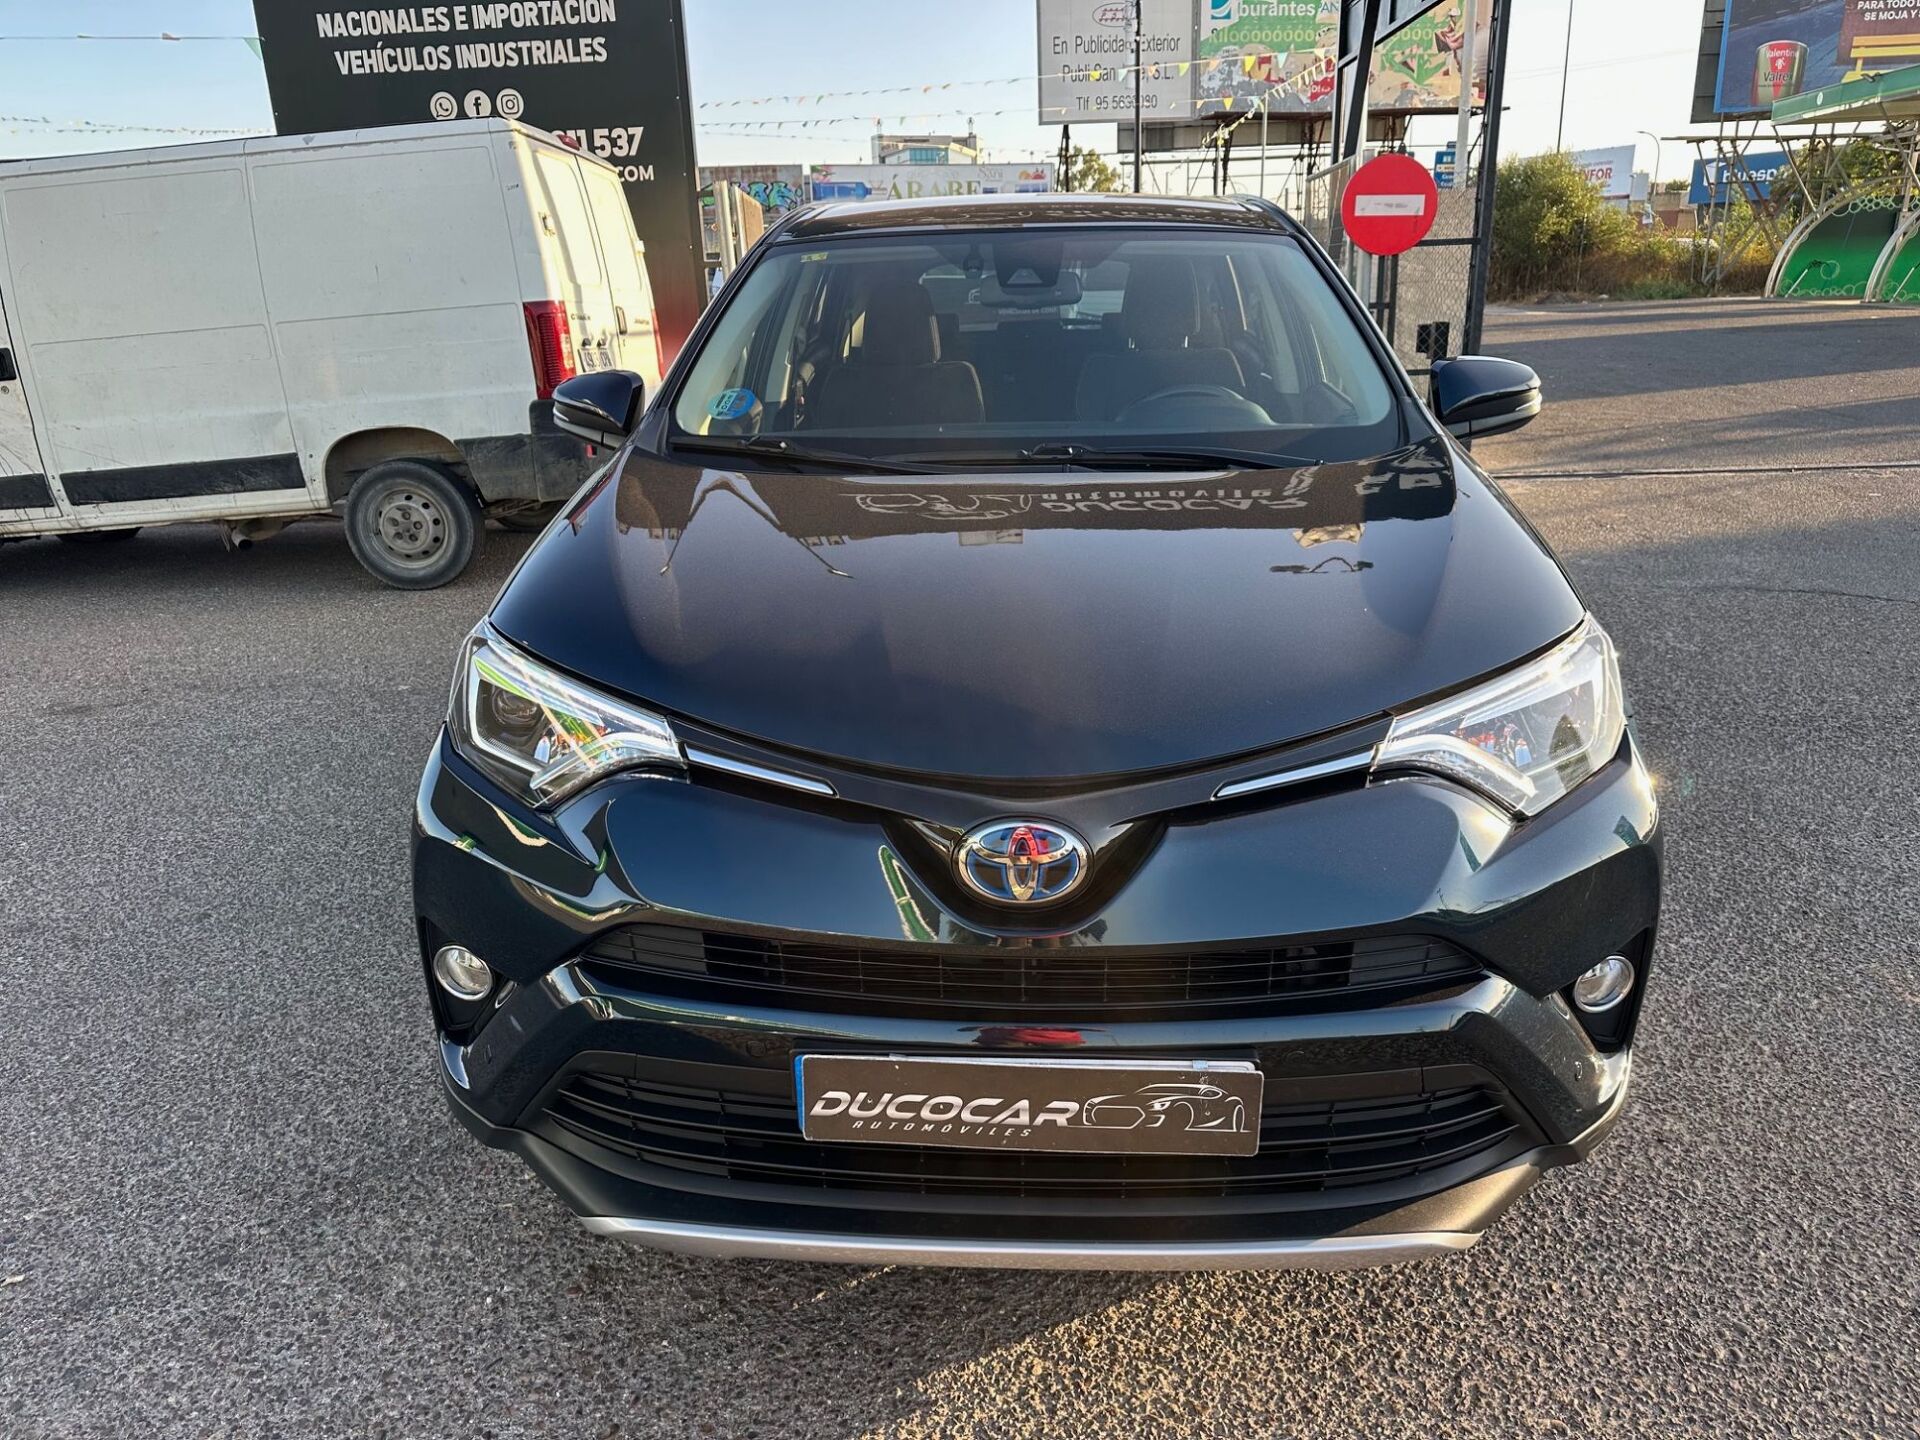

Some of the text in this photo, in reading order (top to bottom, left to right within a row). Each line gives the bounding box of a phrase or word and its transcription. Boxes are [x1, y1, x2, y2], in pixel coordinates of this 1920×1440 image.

[1857, 1, 1884, 9] PARA
[1887, 0, 1915, 8] TODO
[316, 6, 450, 38] NACIONALES
[453, 5, 468, 30] E
[1864, 9, 1918, 20] SE MOJA Y
[1053, 36, 1068, 54] En
[334, 36, 608, 75] VEHÍCULOS INDUSTRIALES
[1076, 96, 1090, 110] Tlf
[1095, 95, 1109, 110] 95
[593, 126, 644, 158] 537
[810, 1091, 1079, 1126] DUCOCAR
[852, 1120, 1032, 1136] AUTOMÓVILES
